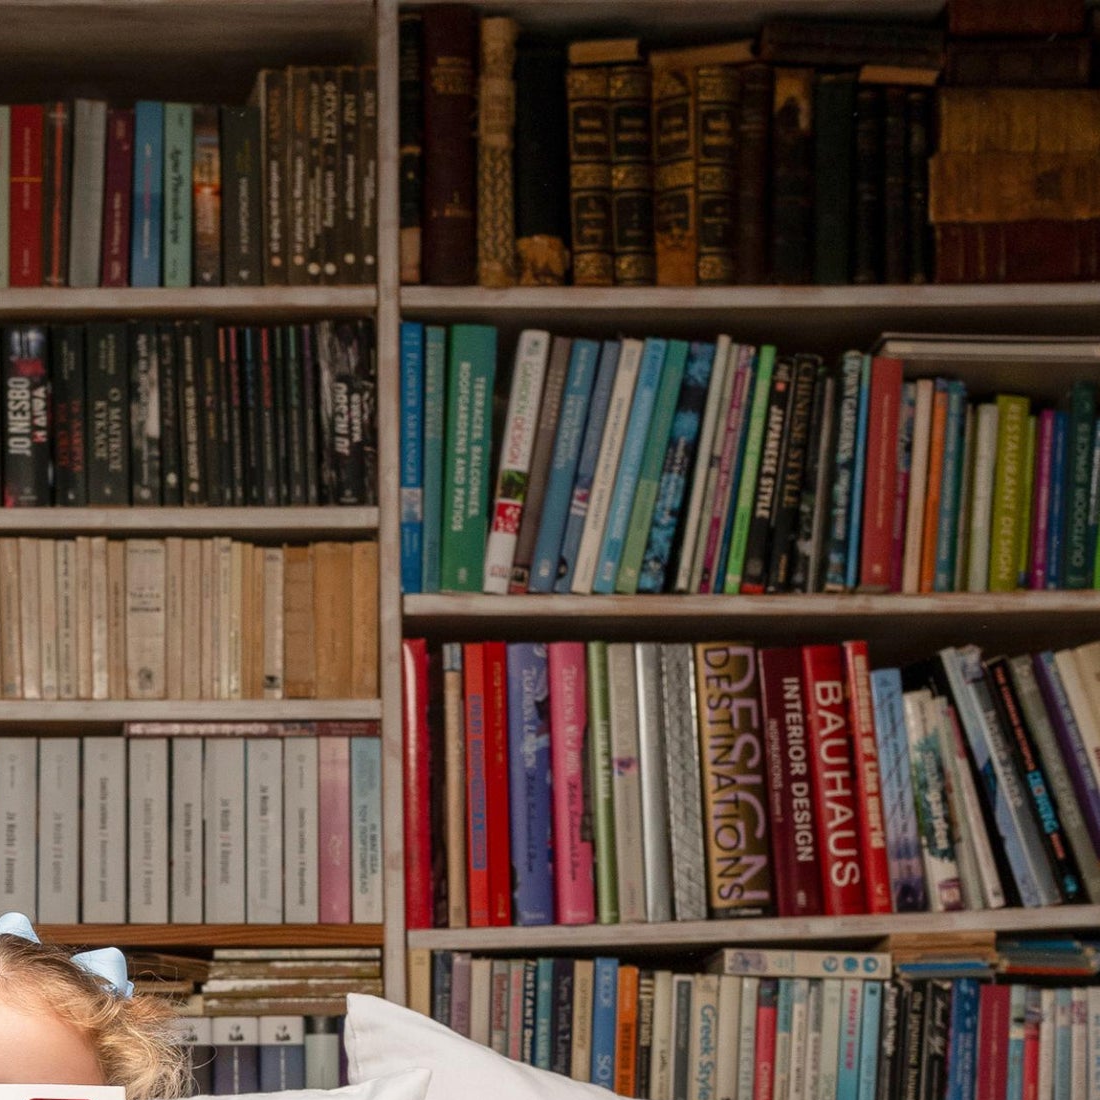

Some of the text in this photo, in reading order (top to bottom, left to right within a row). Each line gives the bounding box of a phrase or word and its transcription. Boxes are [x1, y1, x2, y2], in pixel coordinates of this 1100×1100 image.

[7, 437, 32, 457] JO
[451, 361, 471, 531] ROOFGARDENS AND PATIOS
[508, 416, 526, 465] DESIGN
[755, 405, 783, 519] JAPANESE STYLE
[782, 450, 804, 507] STYLE
[998, 403, 1022, 581] RESTAURANT DESIGN
[1071, 423, 1091, 568] OUTDOOR SPACES
[704, 647, 745, 901] DESTINATIONS
[705, 646, 768, 901] DESIGN
[782, 676, 814, 862] INTERIOR DESIGN
[814, 680, 861, 888] BAUHAUS
[867, 796, 885, 849] world
[523, 967, 535, 1027] INSTANT
[553, 975, 571, 1074] New York Living
[578, 977, 590, 1049] contemporary
[700, 1004, 716, 1056] Greek
[844, 987, 858, 1070] PRIVATE VIEW
